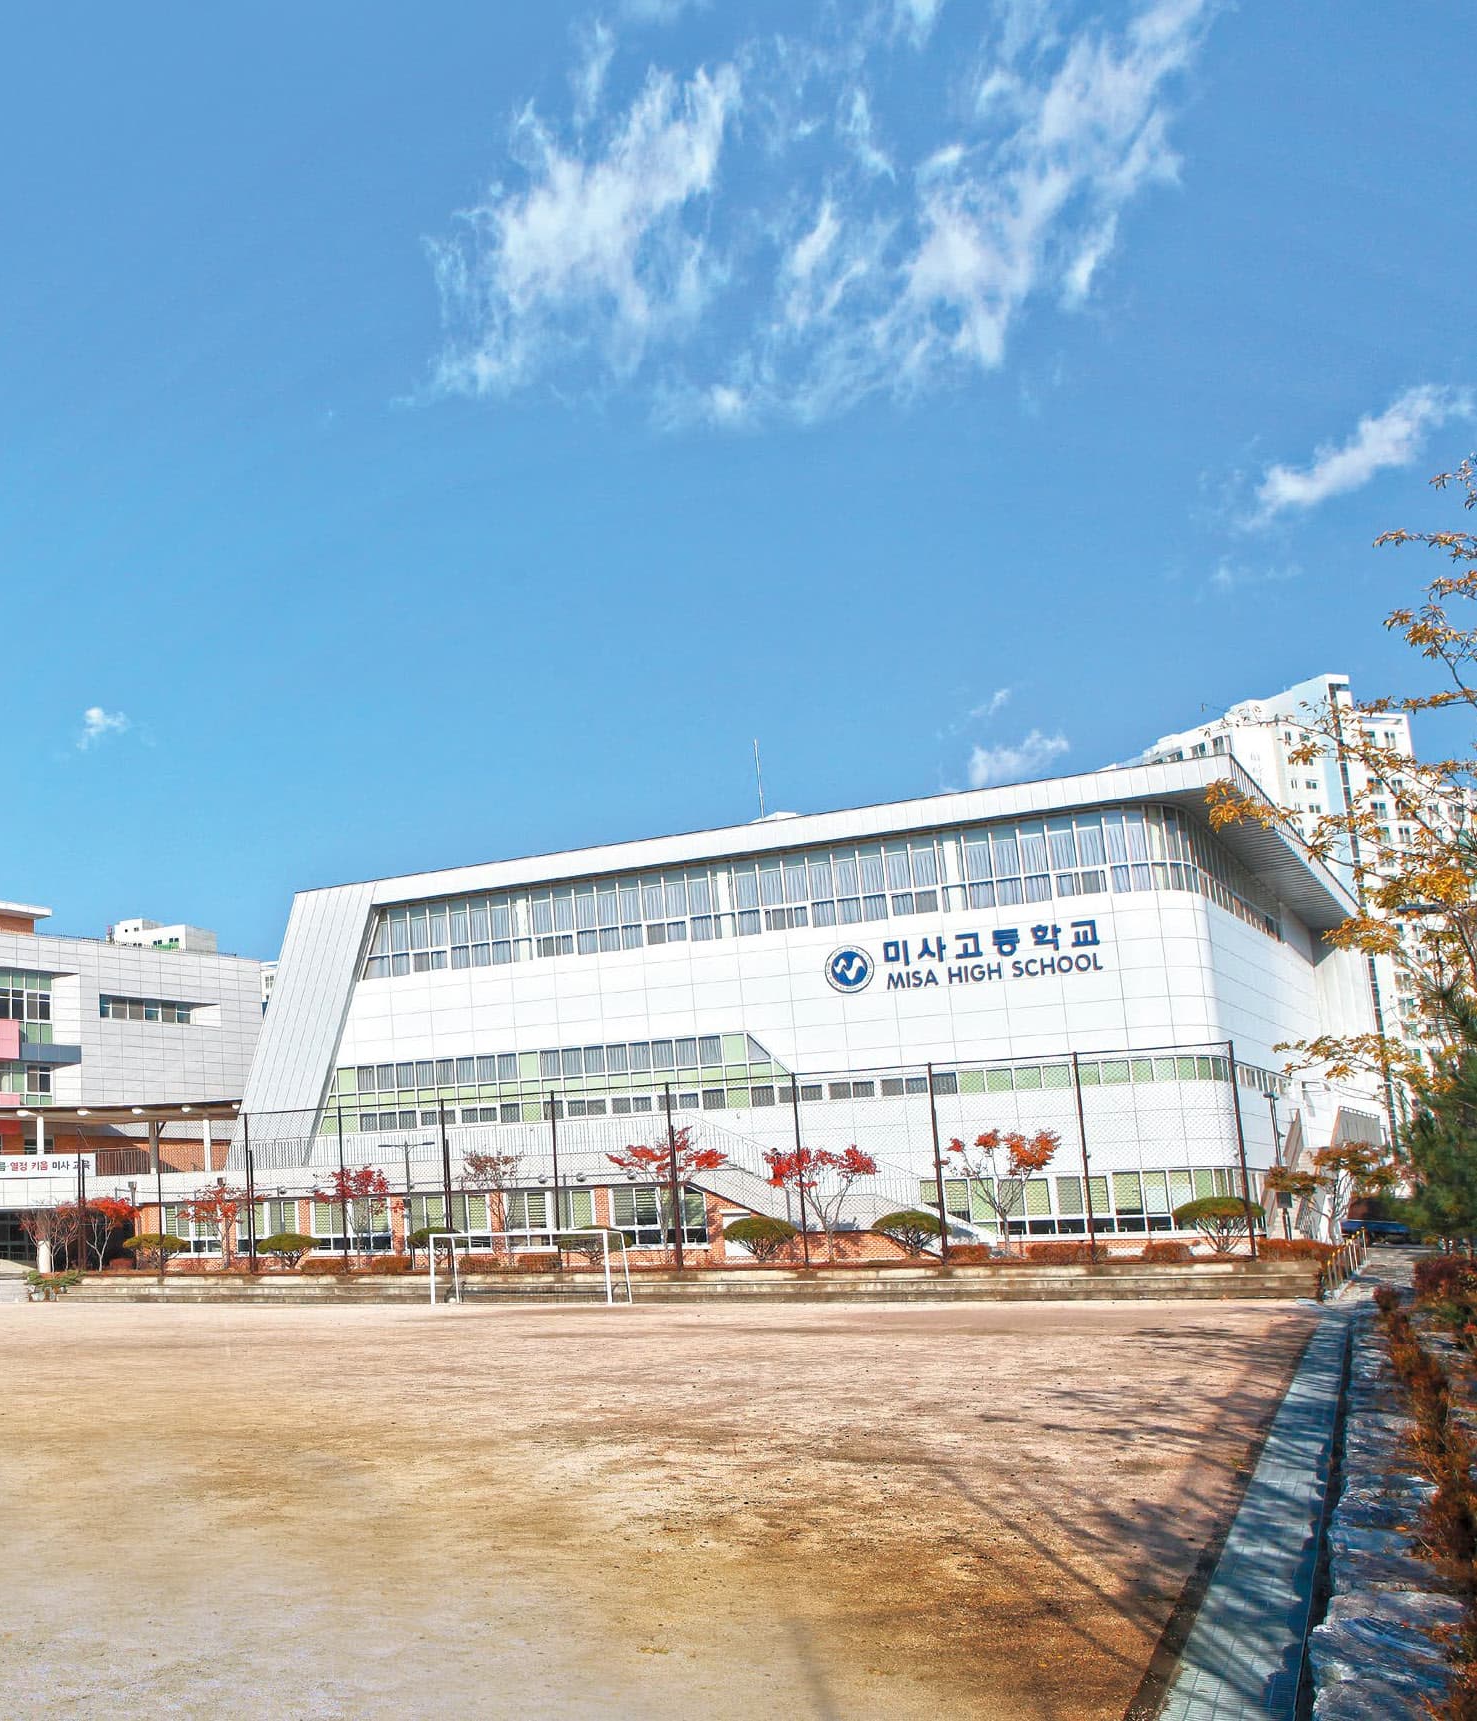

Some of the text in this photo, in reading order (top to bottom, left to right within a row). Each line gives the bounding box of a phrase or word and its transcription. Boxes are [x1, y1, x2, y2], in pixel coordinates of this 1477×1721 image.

[883, 919, 1101, 966] 미사고등학교
[886, 967, 939, 990] MISA
[947, 961, 1003, 984] HIGH
[1011, 952, 1104, 978] SCHOOL
[31, 1160, 49, 1171] 키움
[52, 1160, 70, 1170] 미사
